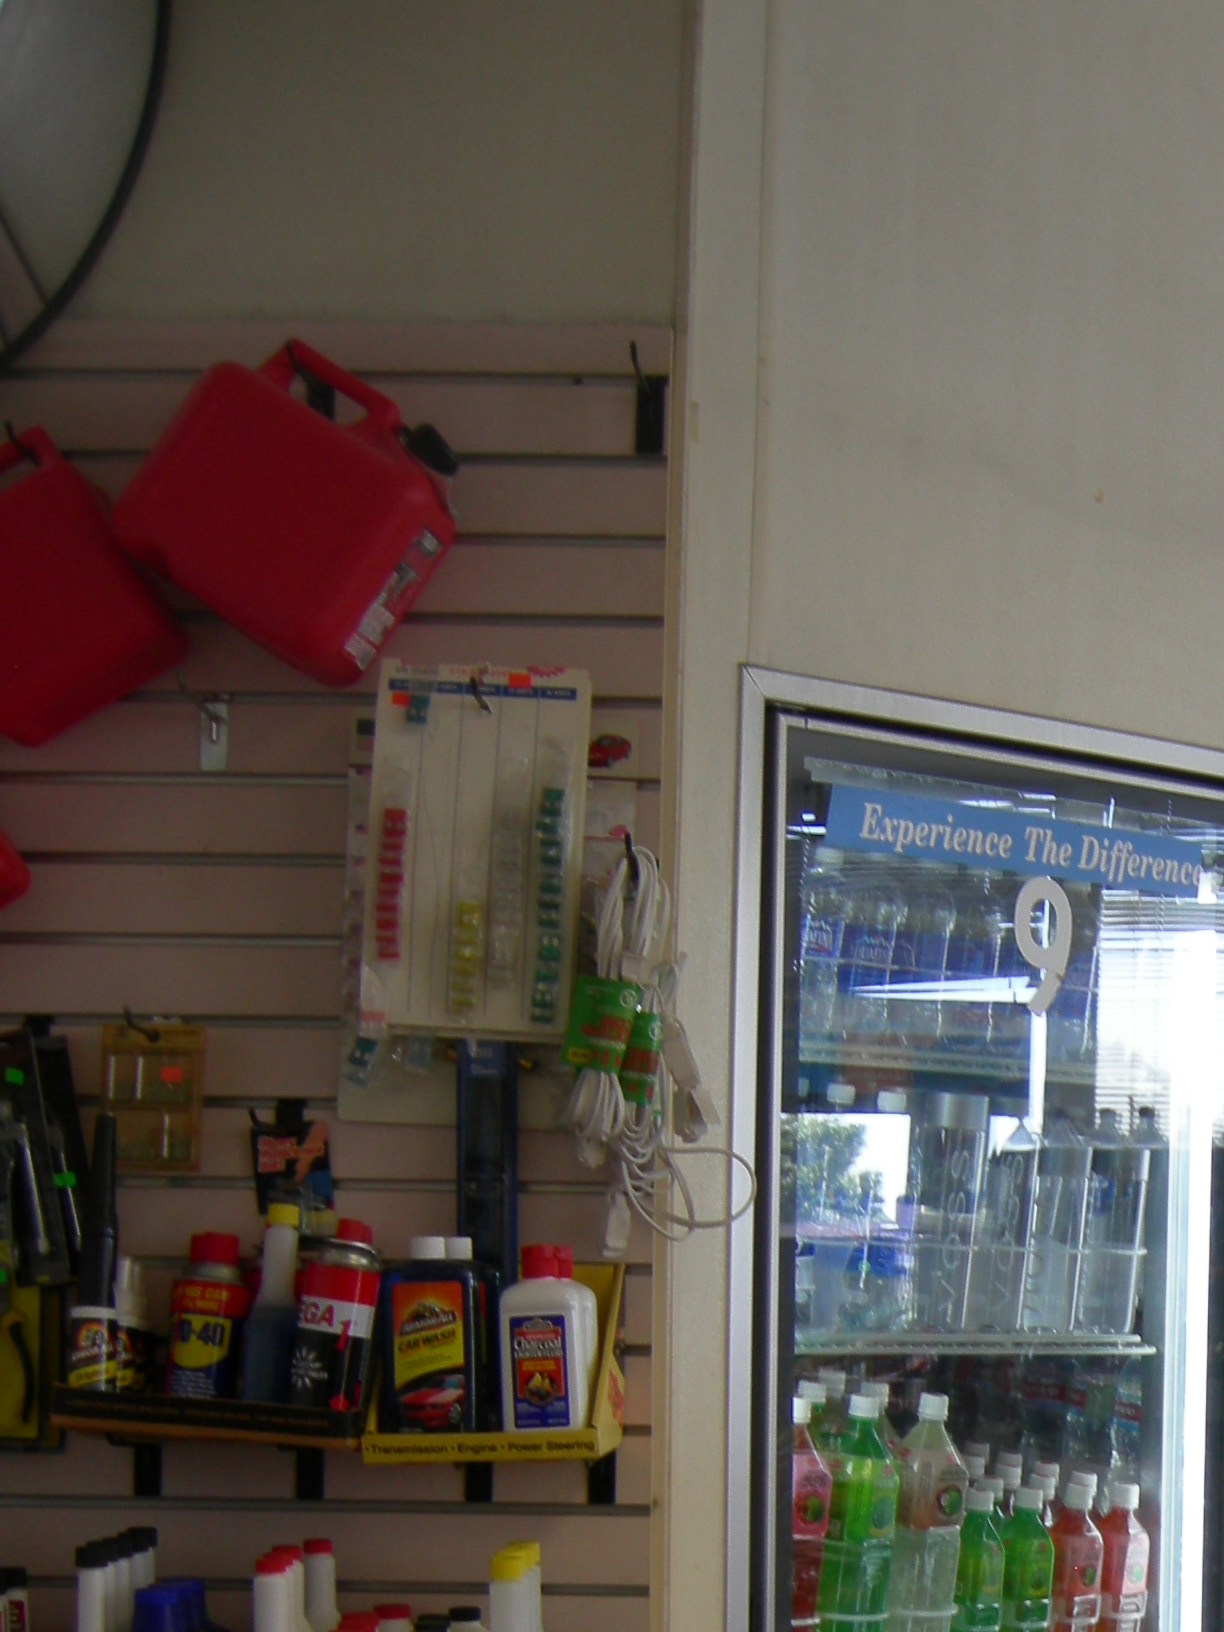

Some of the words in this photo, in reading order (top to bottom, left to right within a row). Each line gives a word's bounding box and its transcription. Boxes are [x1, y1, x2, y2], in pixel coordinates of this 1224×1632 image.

[859, 802, 1013, 859] Experience
[1024, 826, 1073, 869] The
[1078, 835, 1202, 886] Difference
[1014, 876, 1072, 1017] 9
[372, 1442, 448, 1455] Transmission
[457, 1442, 498, 1456] Engine
[507, 1441, 543, 1453] Power
[546, 1440, 595, 1454] Steering
